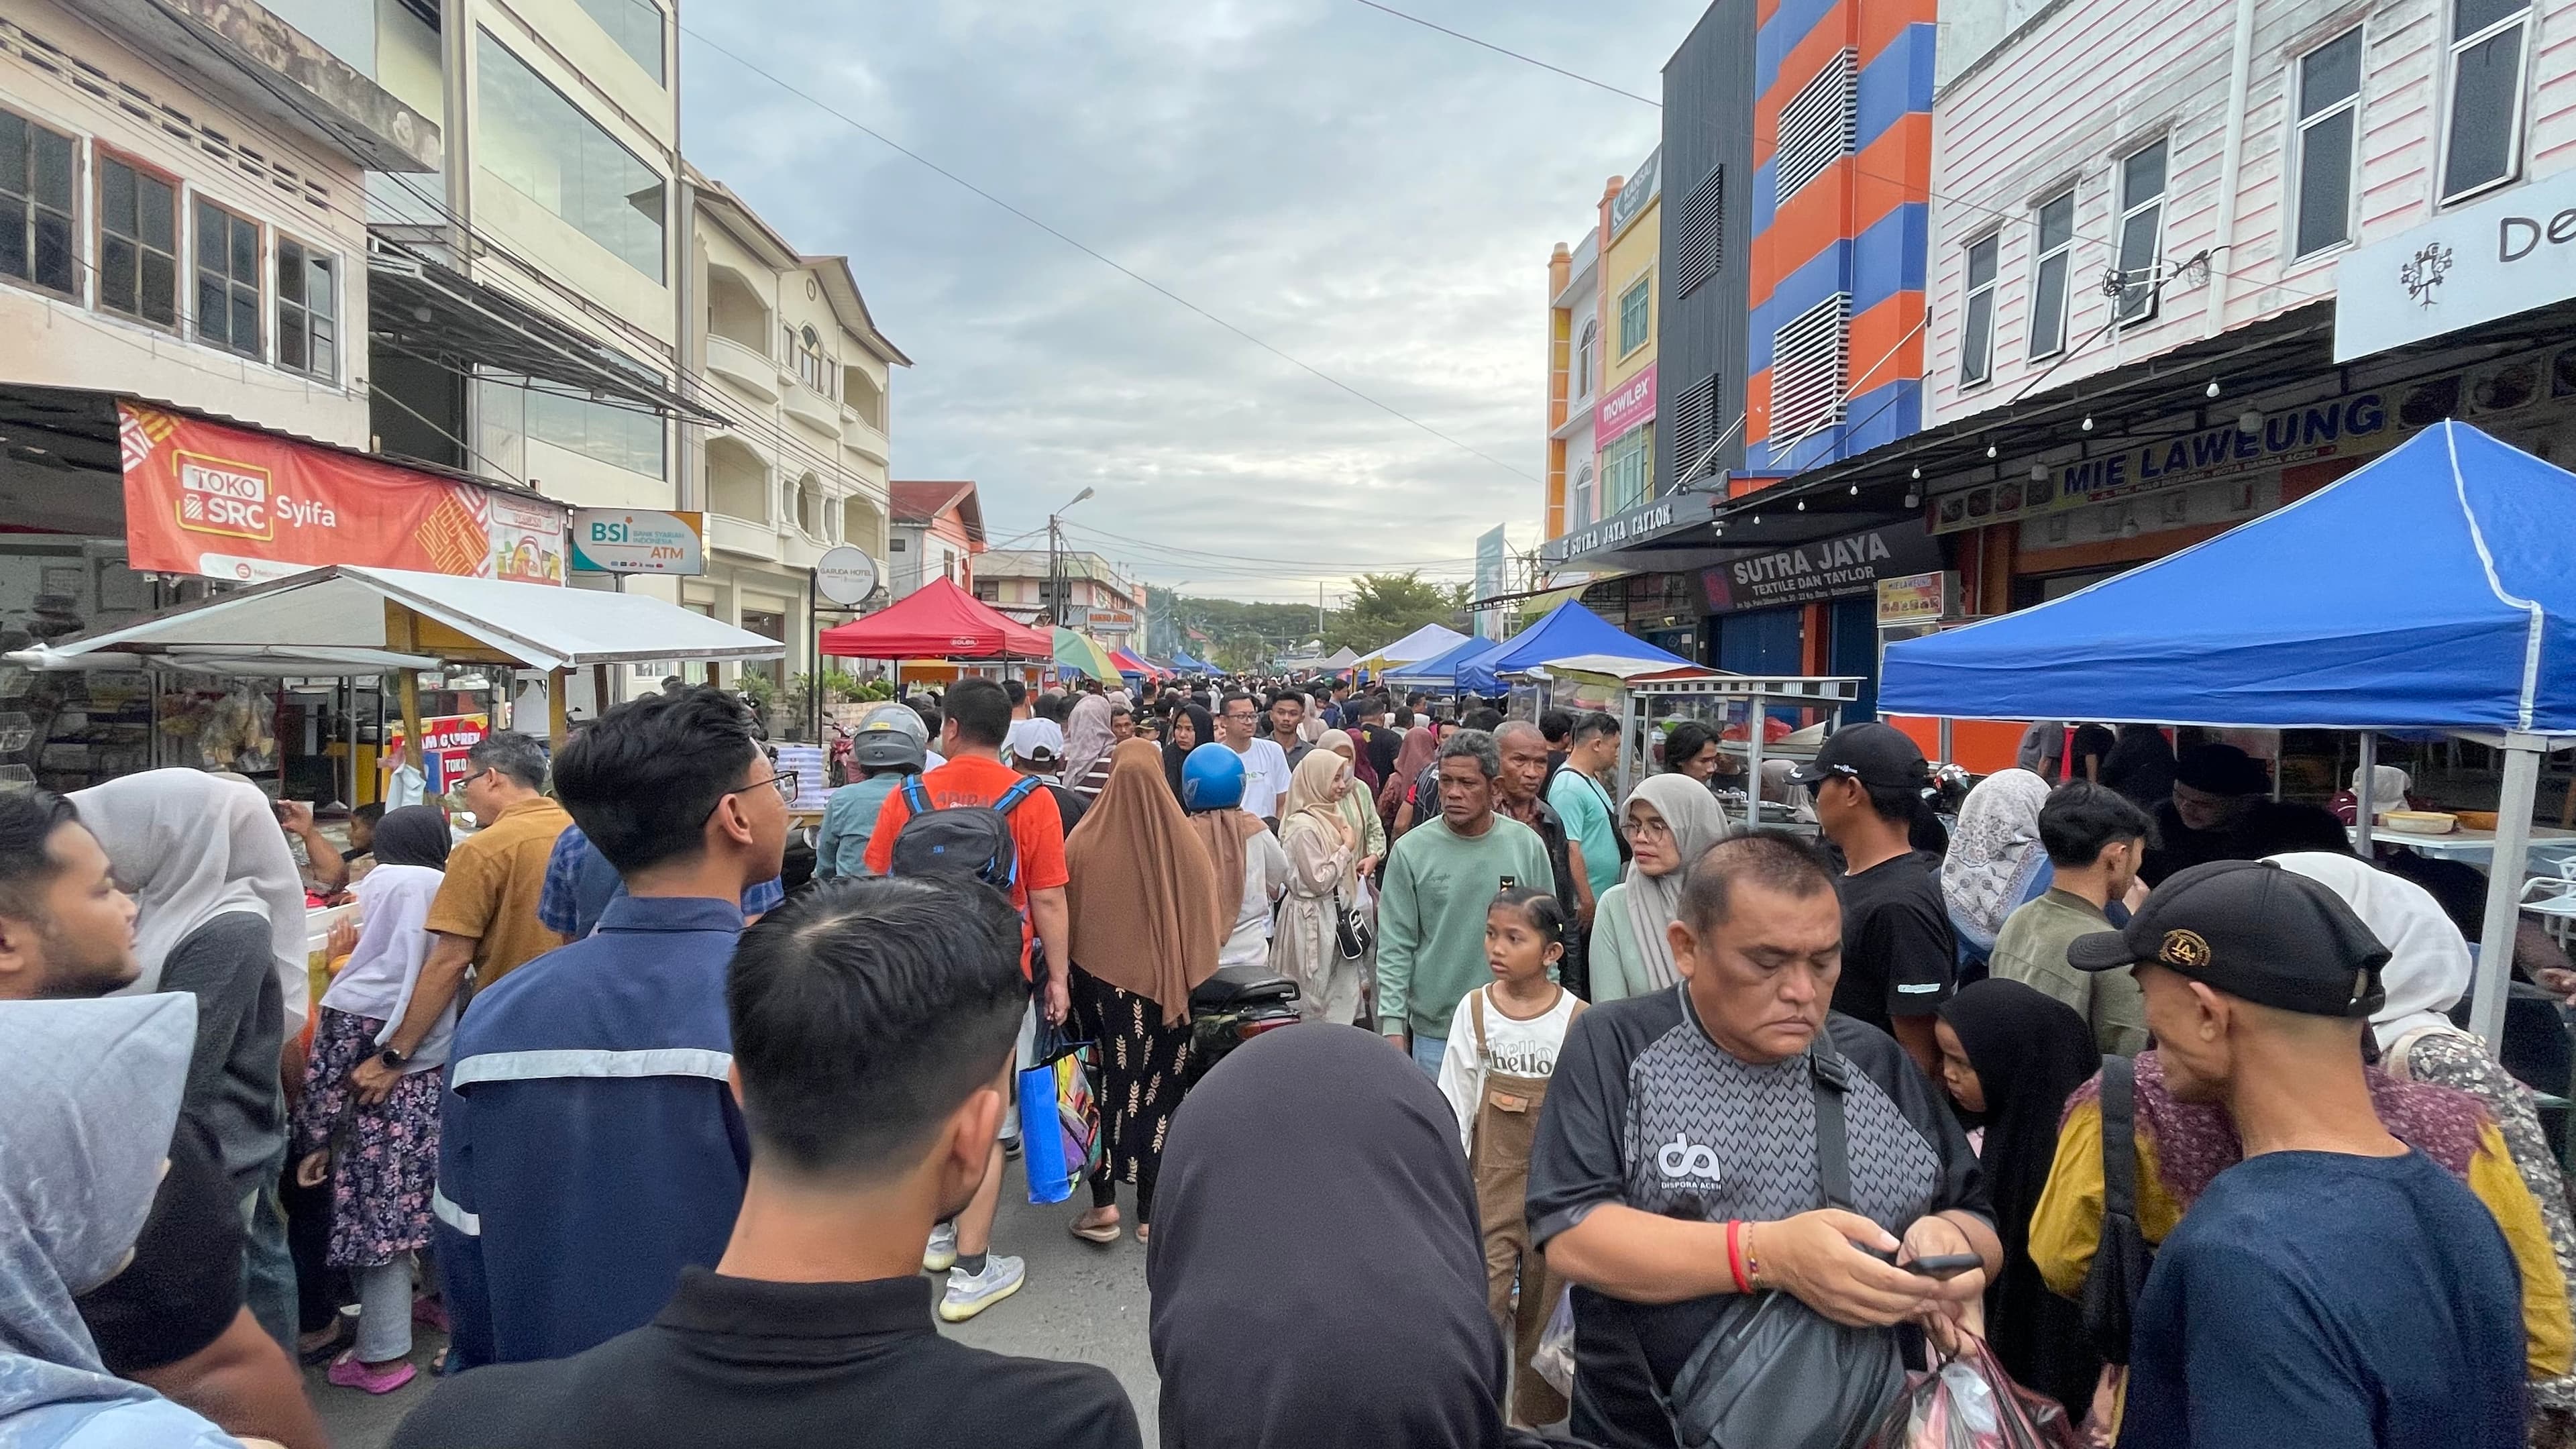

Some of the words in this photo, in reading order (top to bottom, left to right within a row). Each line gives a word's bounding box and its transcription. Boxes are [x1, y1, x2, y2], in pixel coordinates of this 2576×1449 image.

[2063, 454, 2127, 496] MIE
[2141, 394, 2383, 480] LAWEUNG
[193, 468, 256, 498] TOKO
[208, 498, 266, 530] SRC
[276, 495, 336, 528] Syifa
[592, 519, 629, 543] BSI
[1572, 530, 1599, 555] SUTRA
[1603, 520, 1627, 545] JAYA
[1632, 504, 1672, 536] TAYLOR
[651, 547, 684, 559] ATM
[1733, 549, 1813, 585] SUTRA
[1817, 533, 1891, 570] JAYA
[1752, 580, 1796, 596] TEXTILE
[1798, 574, 1823, 590] DAN
[1823, 566, 1876, 585] TAYLOR
[445, 759, 467, 773] TOKO
[1491, 1050, 1553, 1075] hello
[1661, 1181, 1698, 1189] DISPORA
[1700, 1181, 1722, 1190] ACEH
